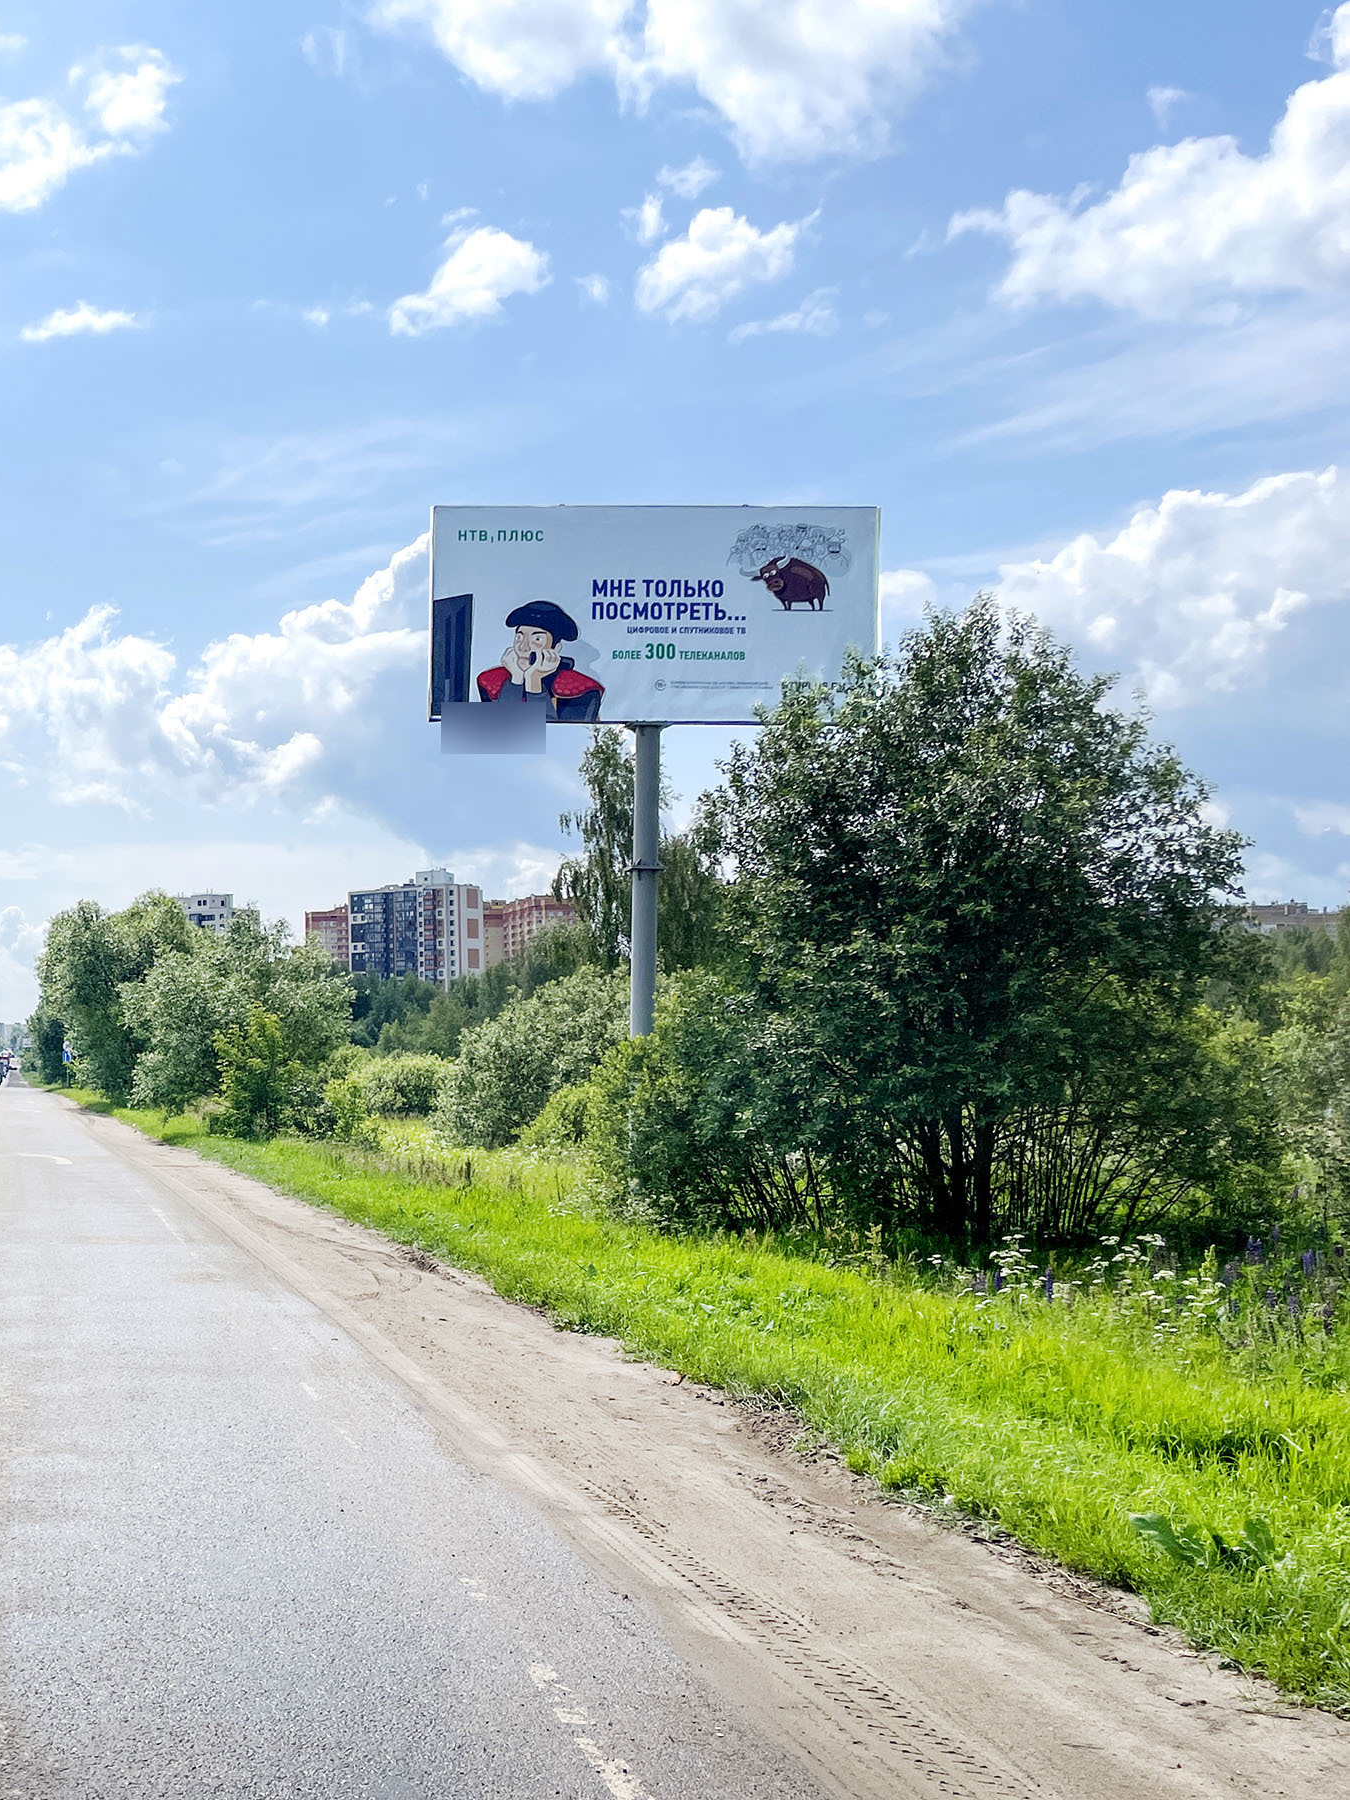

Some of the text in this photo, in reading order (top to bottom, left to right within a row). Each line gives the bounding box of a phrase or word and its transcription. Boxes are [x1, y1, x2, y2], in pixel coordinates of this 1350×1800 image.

[592, 579, 724, 598] МНЕ ТОЛЬКО
[592, 602, 746, 621] ПОСМОТРЕТЬ...
[627, 626, 669, 635] ЦИФРОВОЕ
[612, 643, 746, 660] БОЛЕЕ 300 ТЕЛЕКАНАЛОВ
